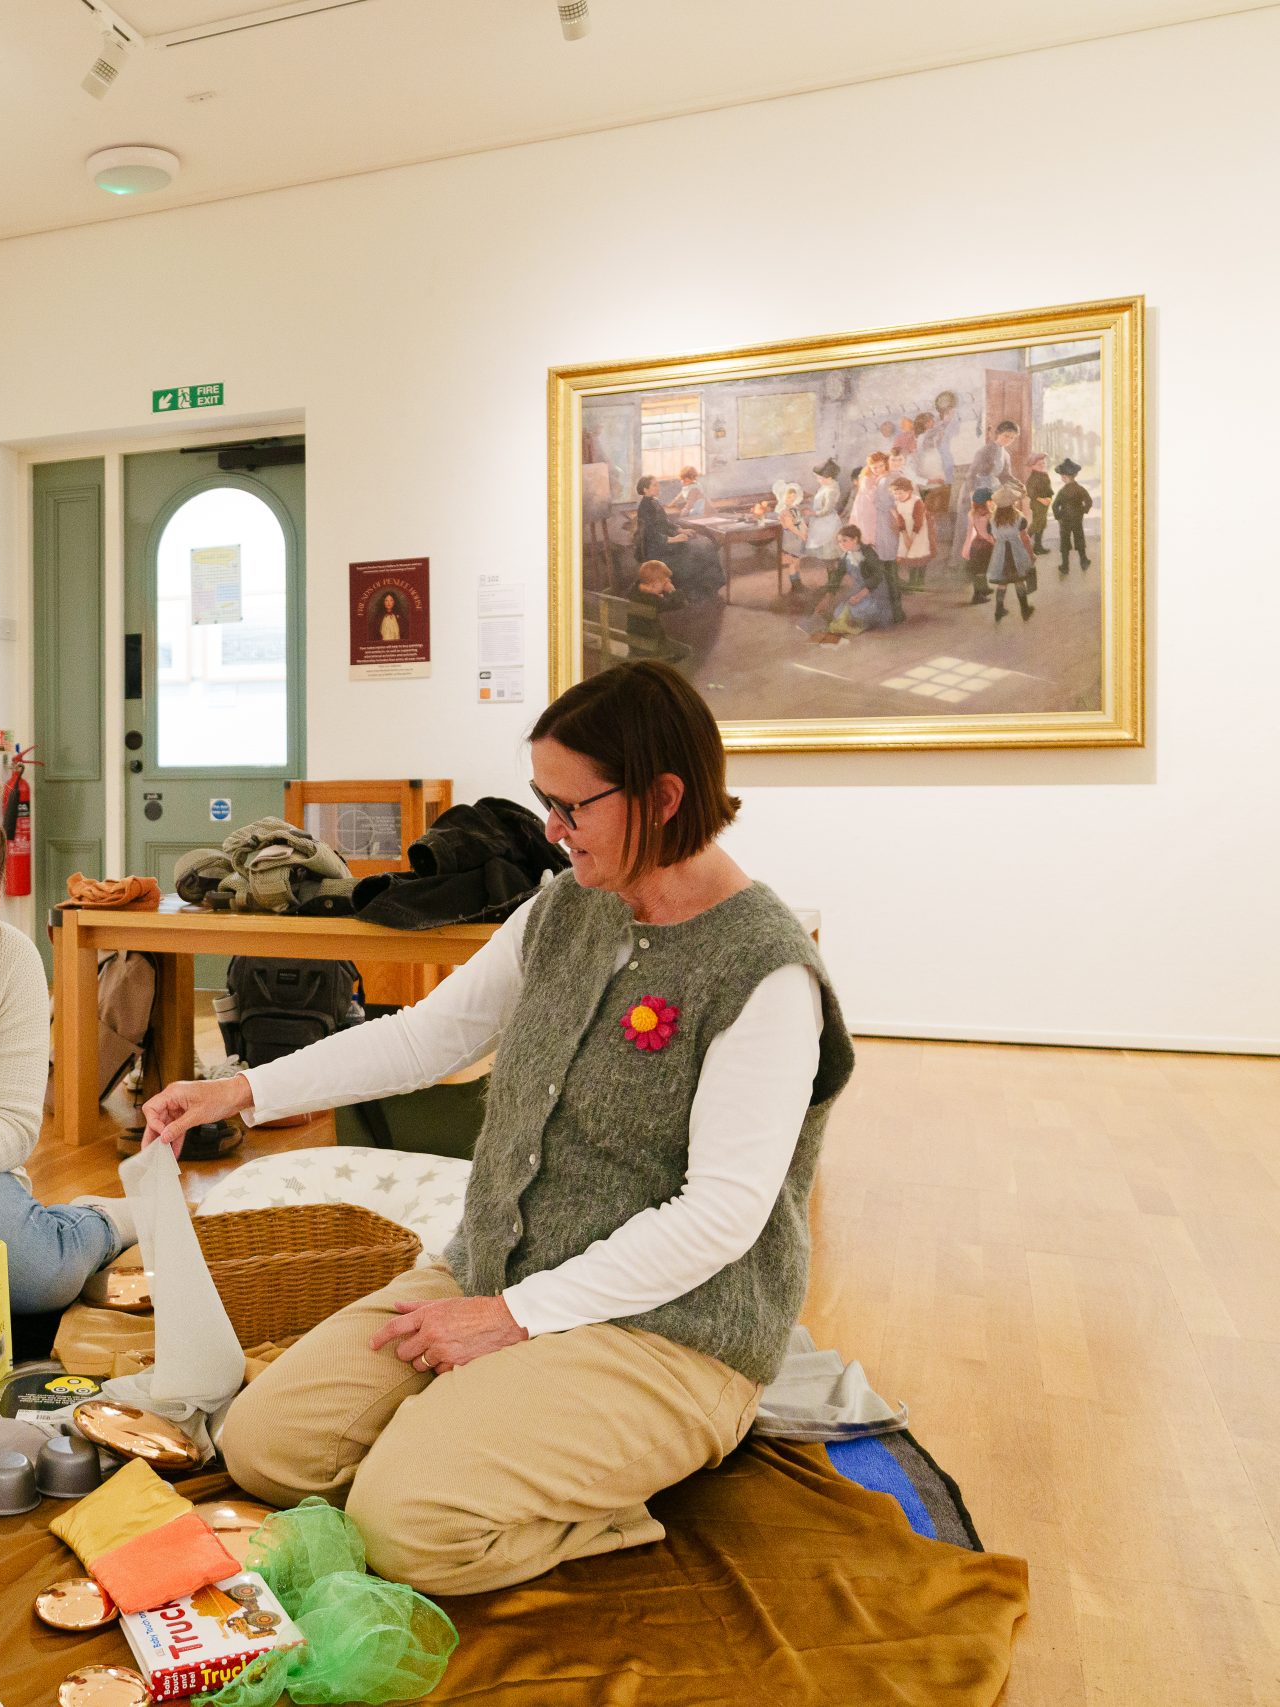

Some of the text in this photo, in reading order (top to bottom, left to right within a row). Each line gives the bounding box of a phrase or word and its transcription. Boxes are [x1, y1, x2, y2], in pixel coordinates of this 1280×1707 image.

[197, 385, 220, 395] FIRE
[197, 395, 220, 406] EXIT
[163, 1675, 171, 1695] Baby
[180, 1674, 188, 1689] and
